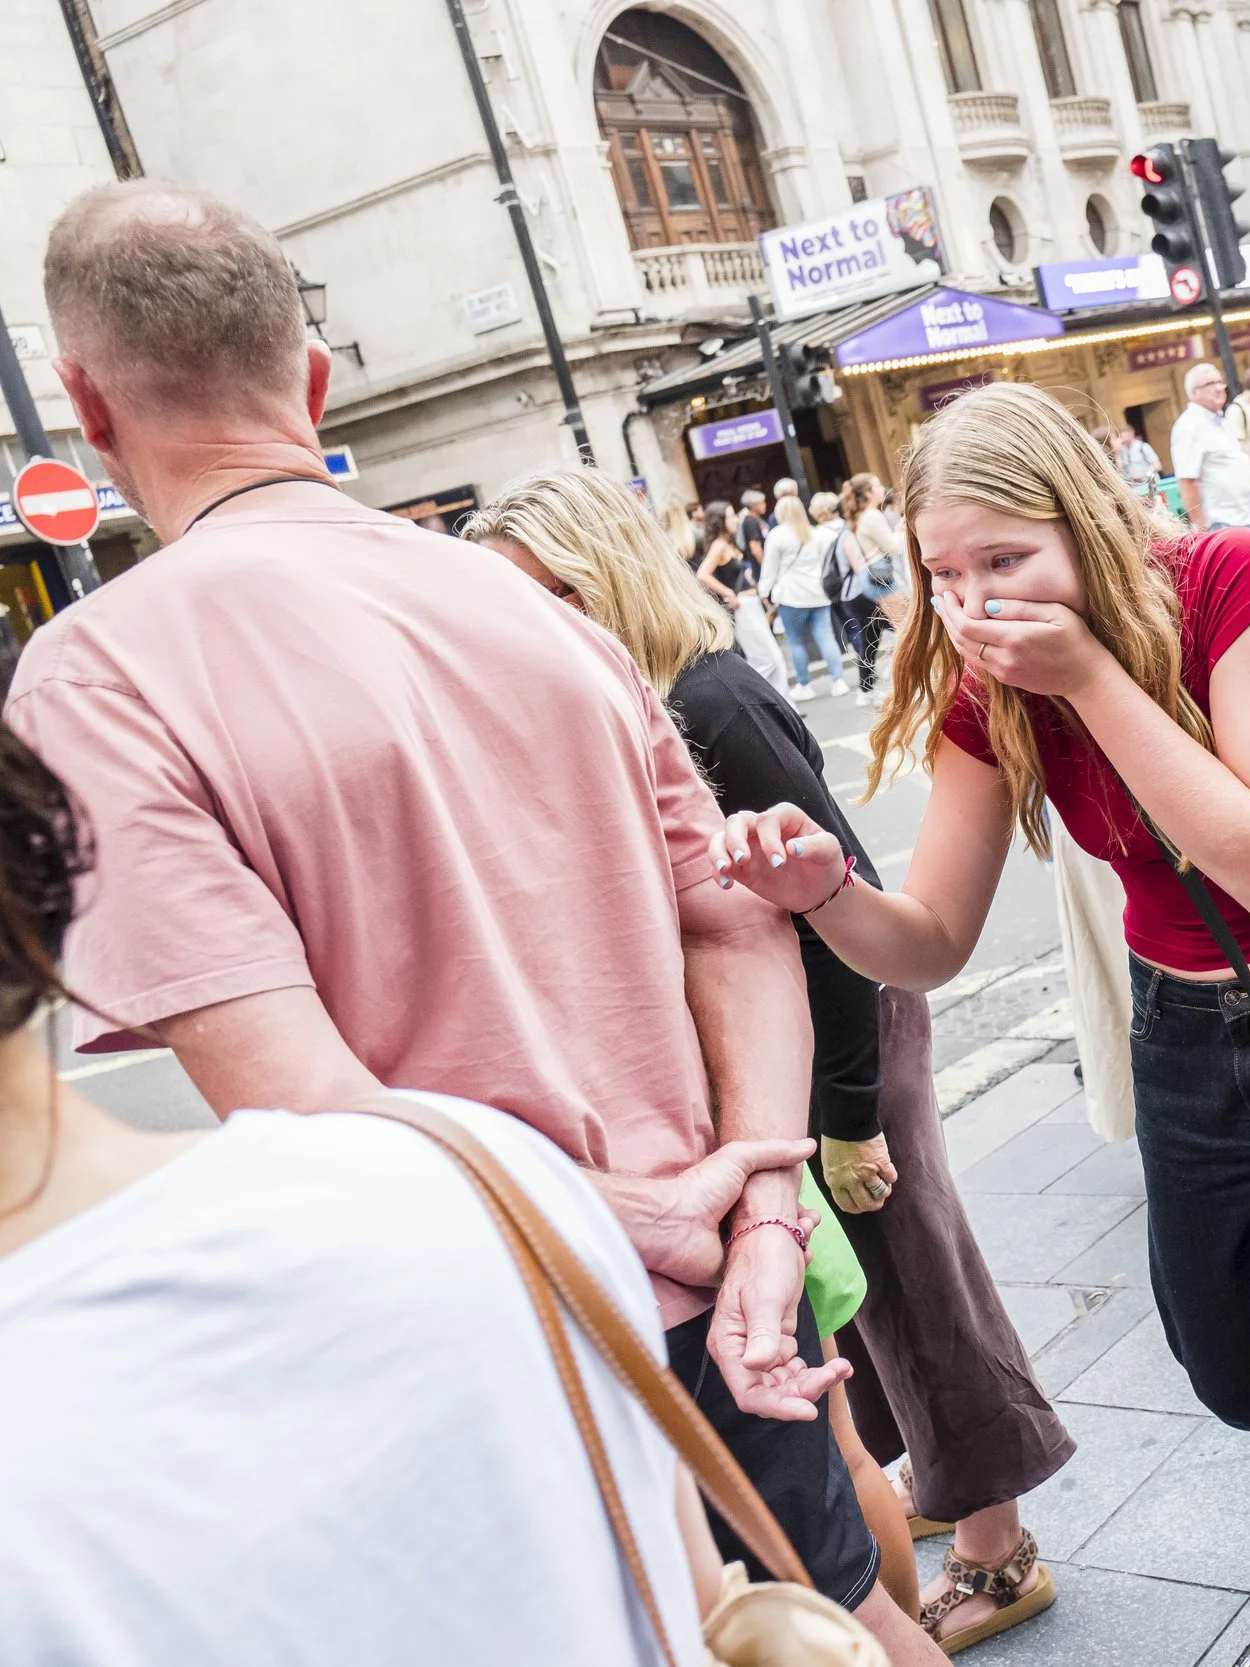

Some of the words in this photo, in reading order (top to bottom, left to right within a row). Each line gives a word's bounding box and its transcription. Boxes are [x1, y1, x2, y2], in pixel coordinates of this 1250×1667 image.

[779, 225, 844, 264] Next
[849, 219, 879, 242] to
[787, 239, 887, 291] Normal
[920, 302, 965, 327] Next
[962, 301, 983, 322] to
[925, 318, 988, 348] Normal
